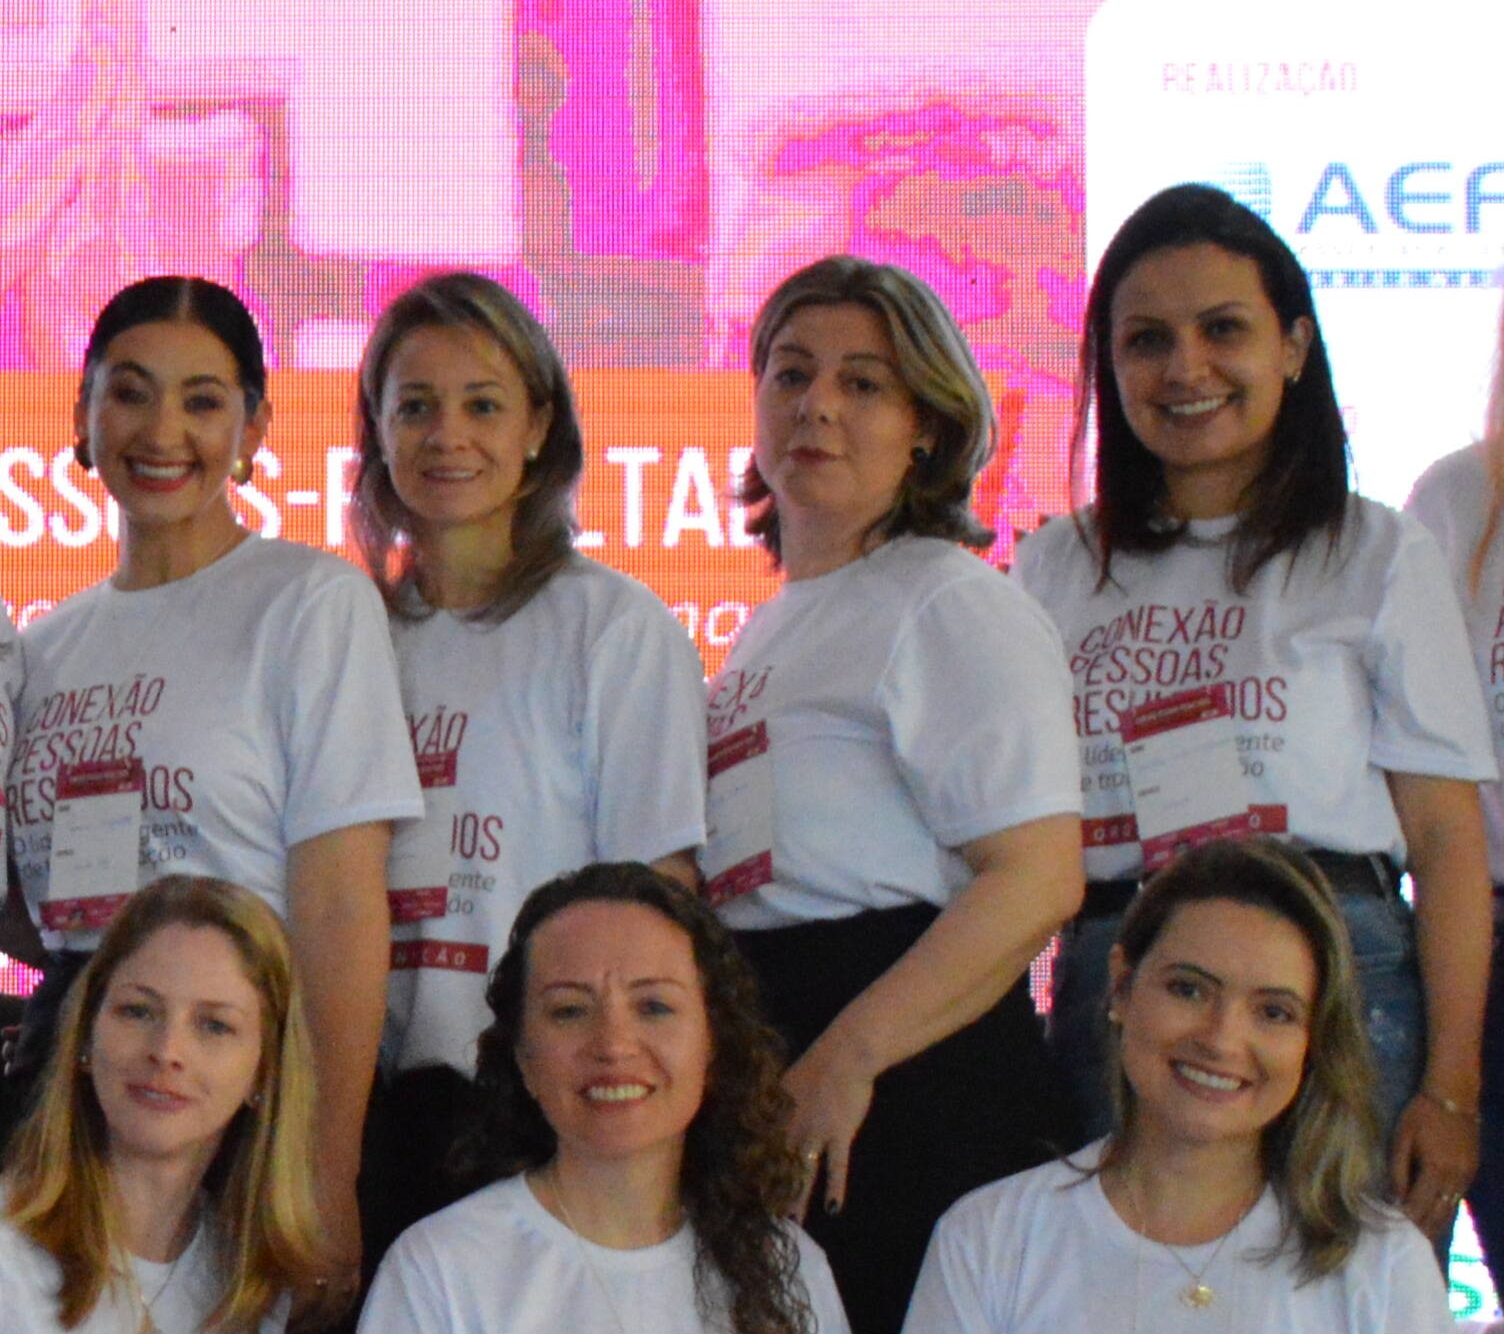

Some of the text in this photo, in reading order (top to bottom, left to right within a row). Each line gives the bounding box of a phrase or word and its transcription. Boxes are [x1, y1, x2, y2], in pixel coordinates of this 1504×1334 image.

[1162, 59, 1358, 98] REALIZAÇÃO
[1080, 599, 1247, 655] CONEXÃO
[1069, 643, 1229, 687] PESSOAS
[27, 673, 165, 734] CONEXÃO
